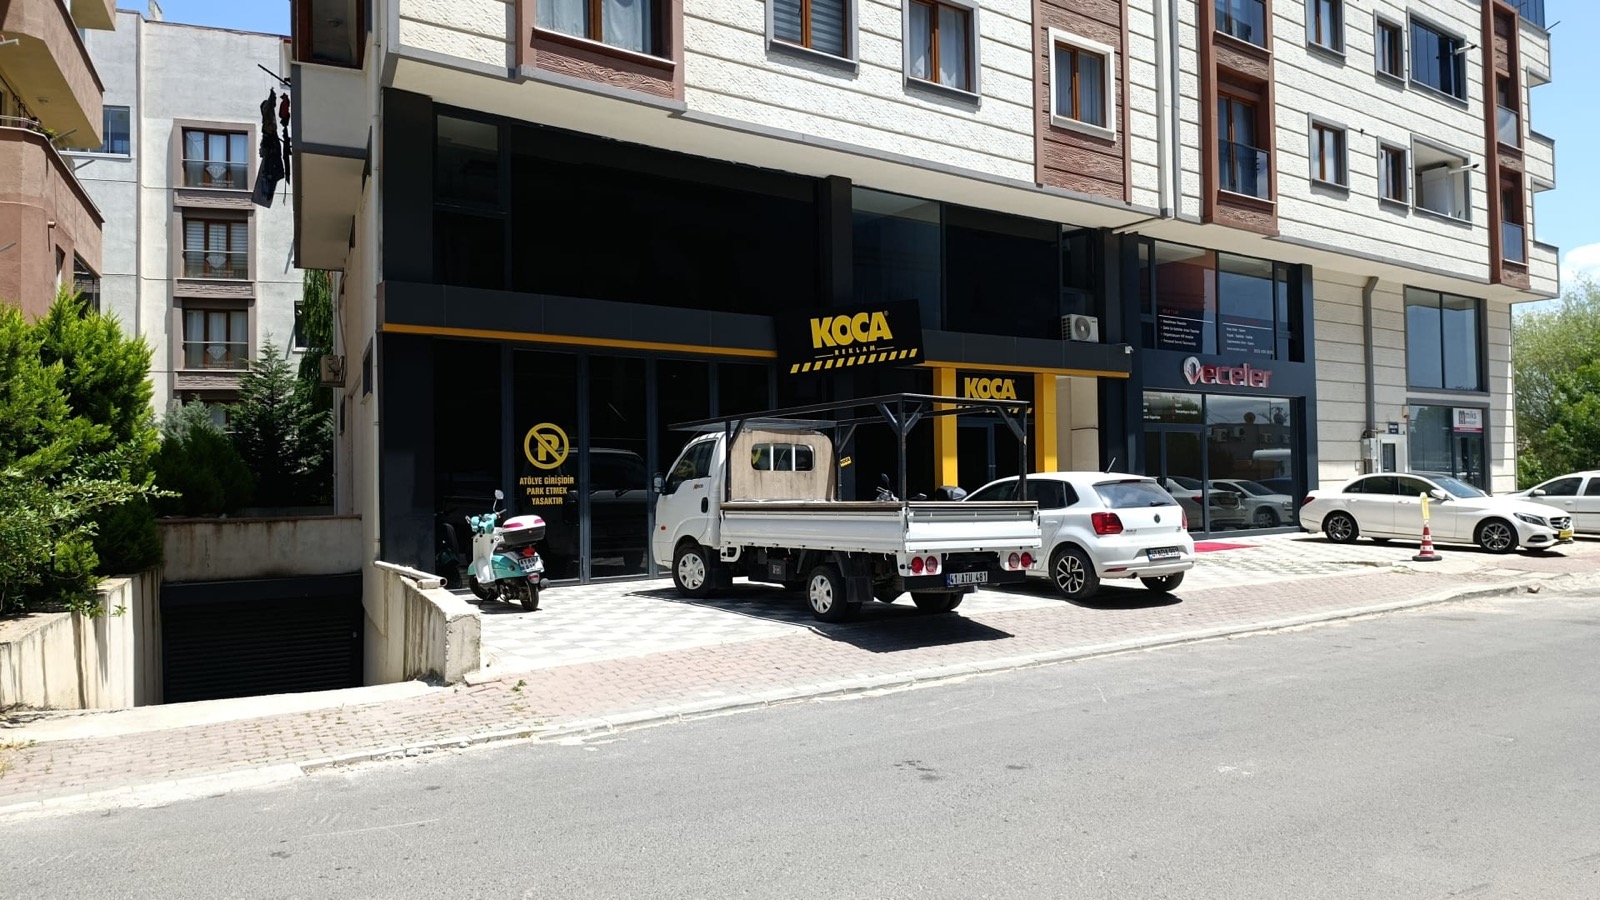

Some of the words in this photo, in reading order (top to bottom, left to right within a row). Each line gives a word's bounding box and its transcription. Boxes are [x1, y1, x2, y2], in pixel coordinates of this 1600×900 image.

[810, 311, 893, 349] KOCA
[834, 345, 876, 356] REKLAM
[964, 377, 1017, 400] KOCA
[519, 475, 543, 485] ATÖLYE
[526, 487, 545, 496] PARK
[545, 487, 568, 495] ETMEK
[531, 497, 563, 506] YASAKTIR
